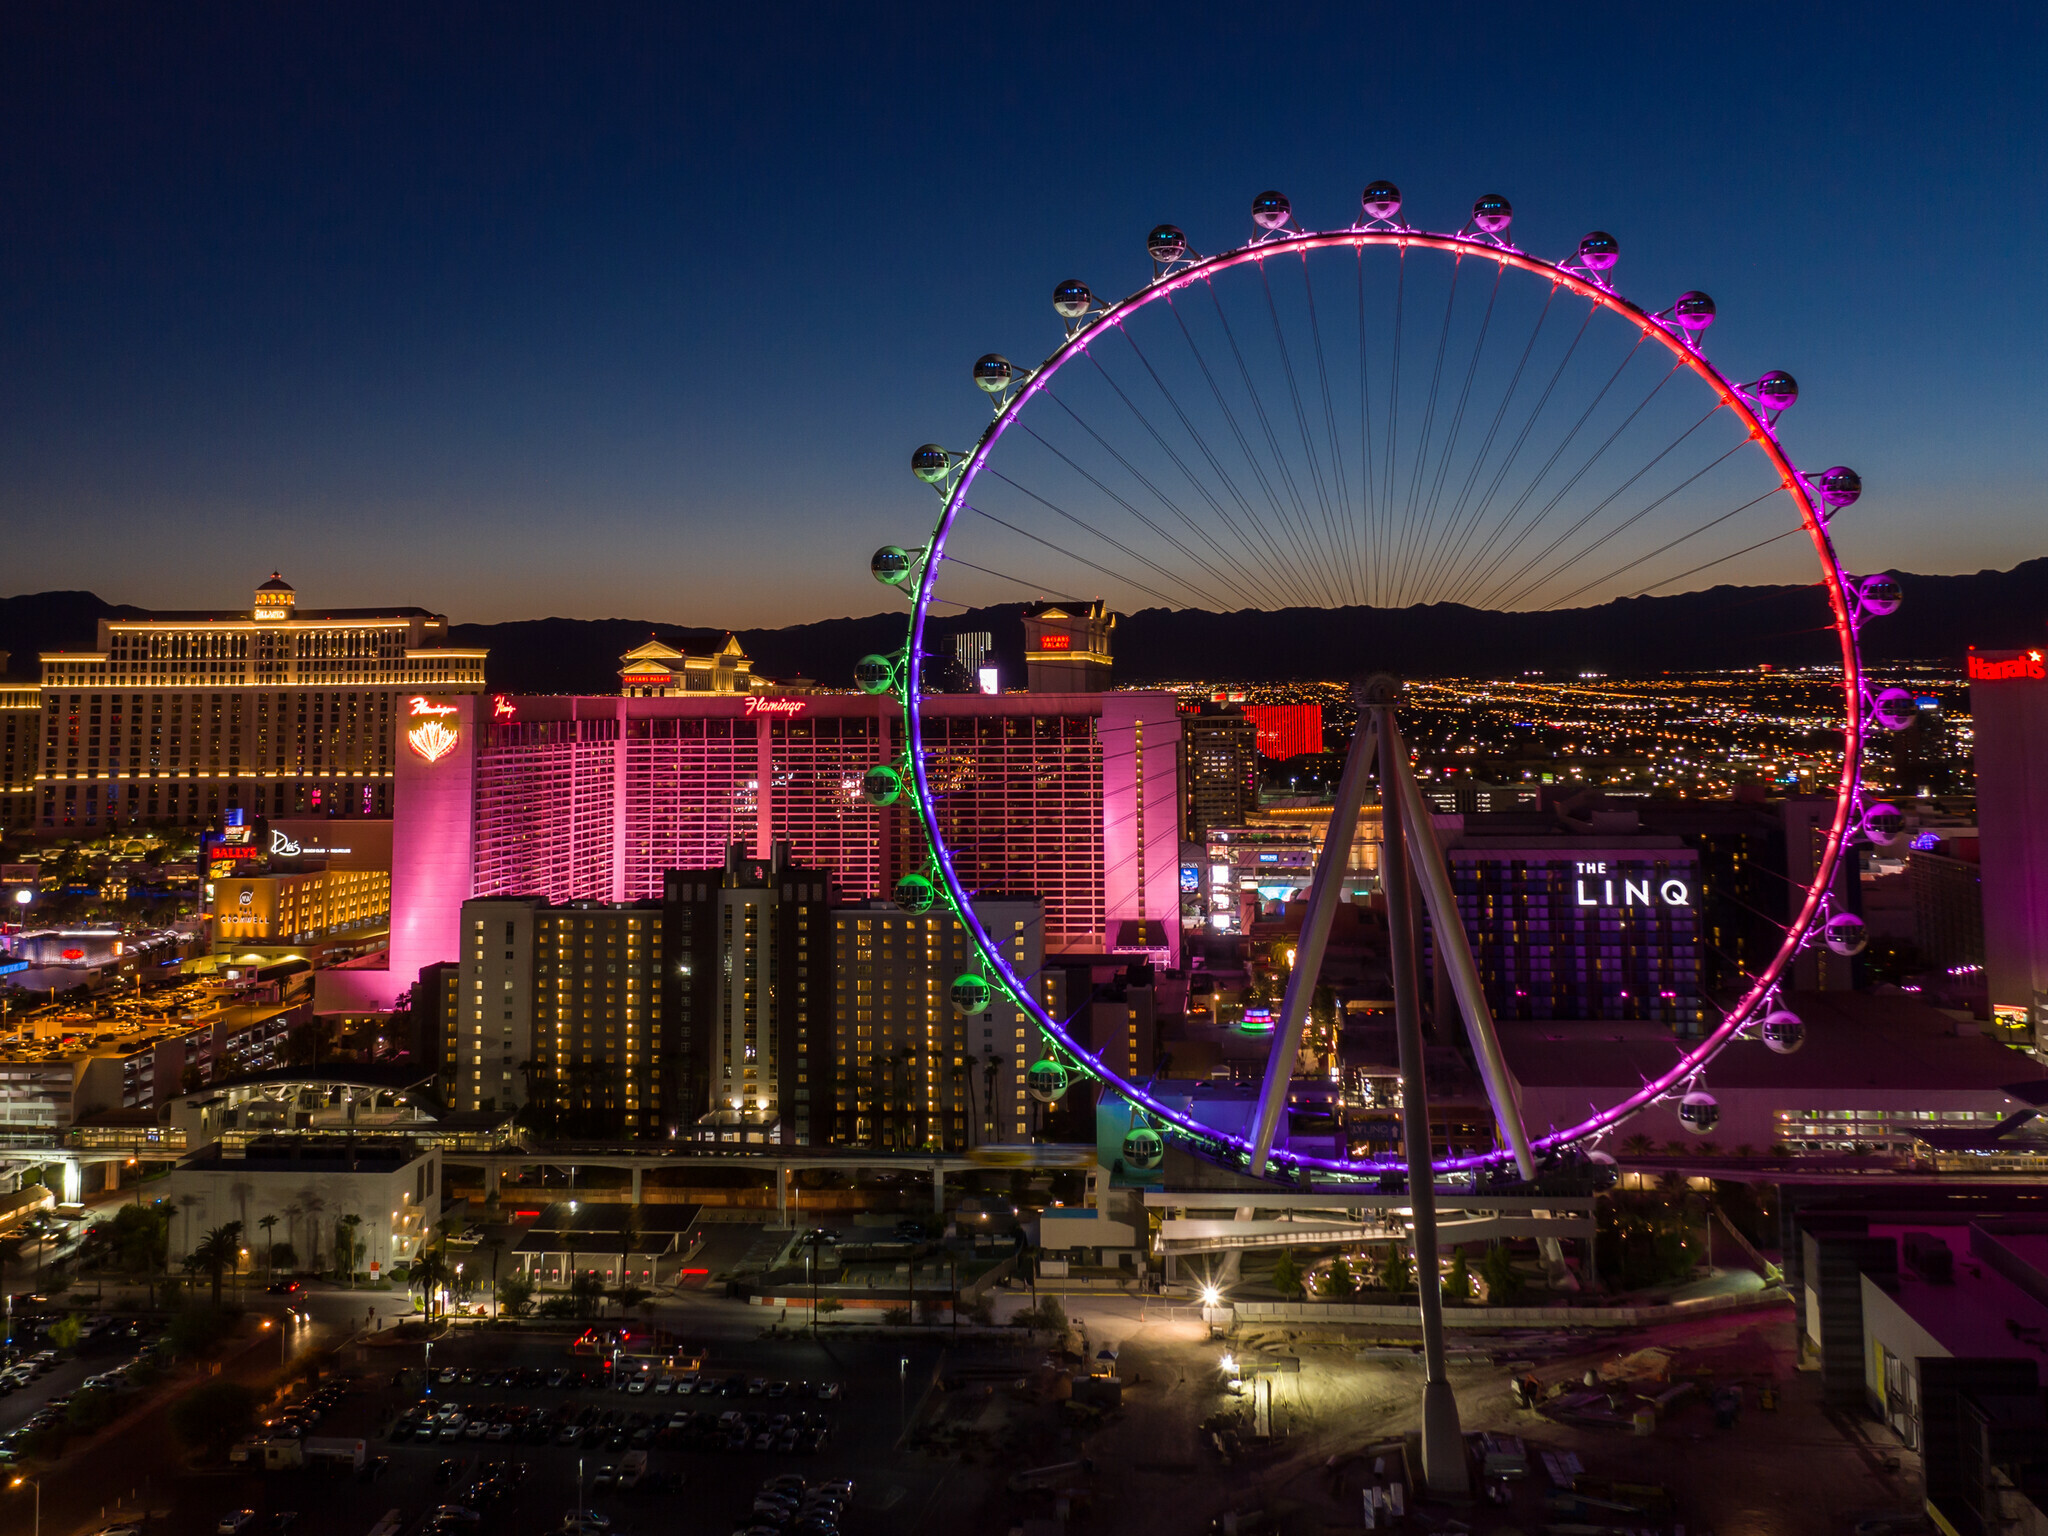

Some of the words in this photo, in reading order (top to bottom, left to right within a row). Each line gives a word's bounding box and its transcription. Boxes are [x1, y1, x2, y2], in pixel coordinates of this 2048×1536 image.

[744, 696, 806, 717] Flamingo
[1576, 862, 1607, 874] THE
[1577, 879, 1690, 906] LINQ
